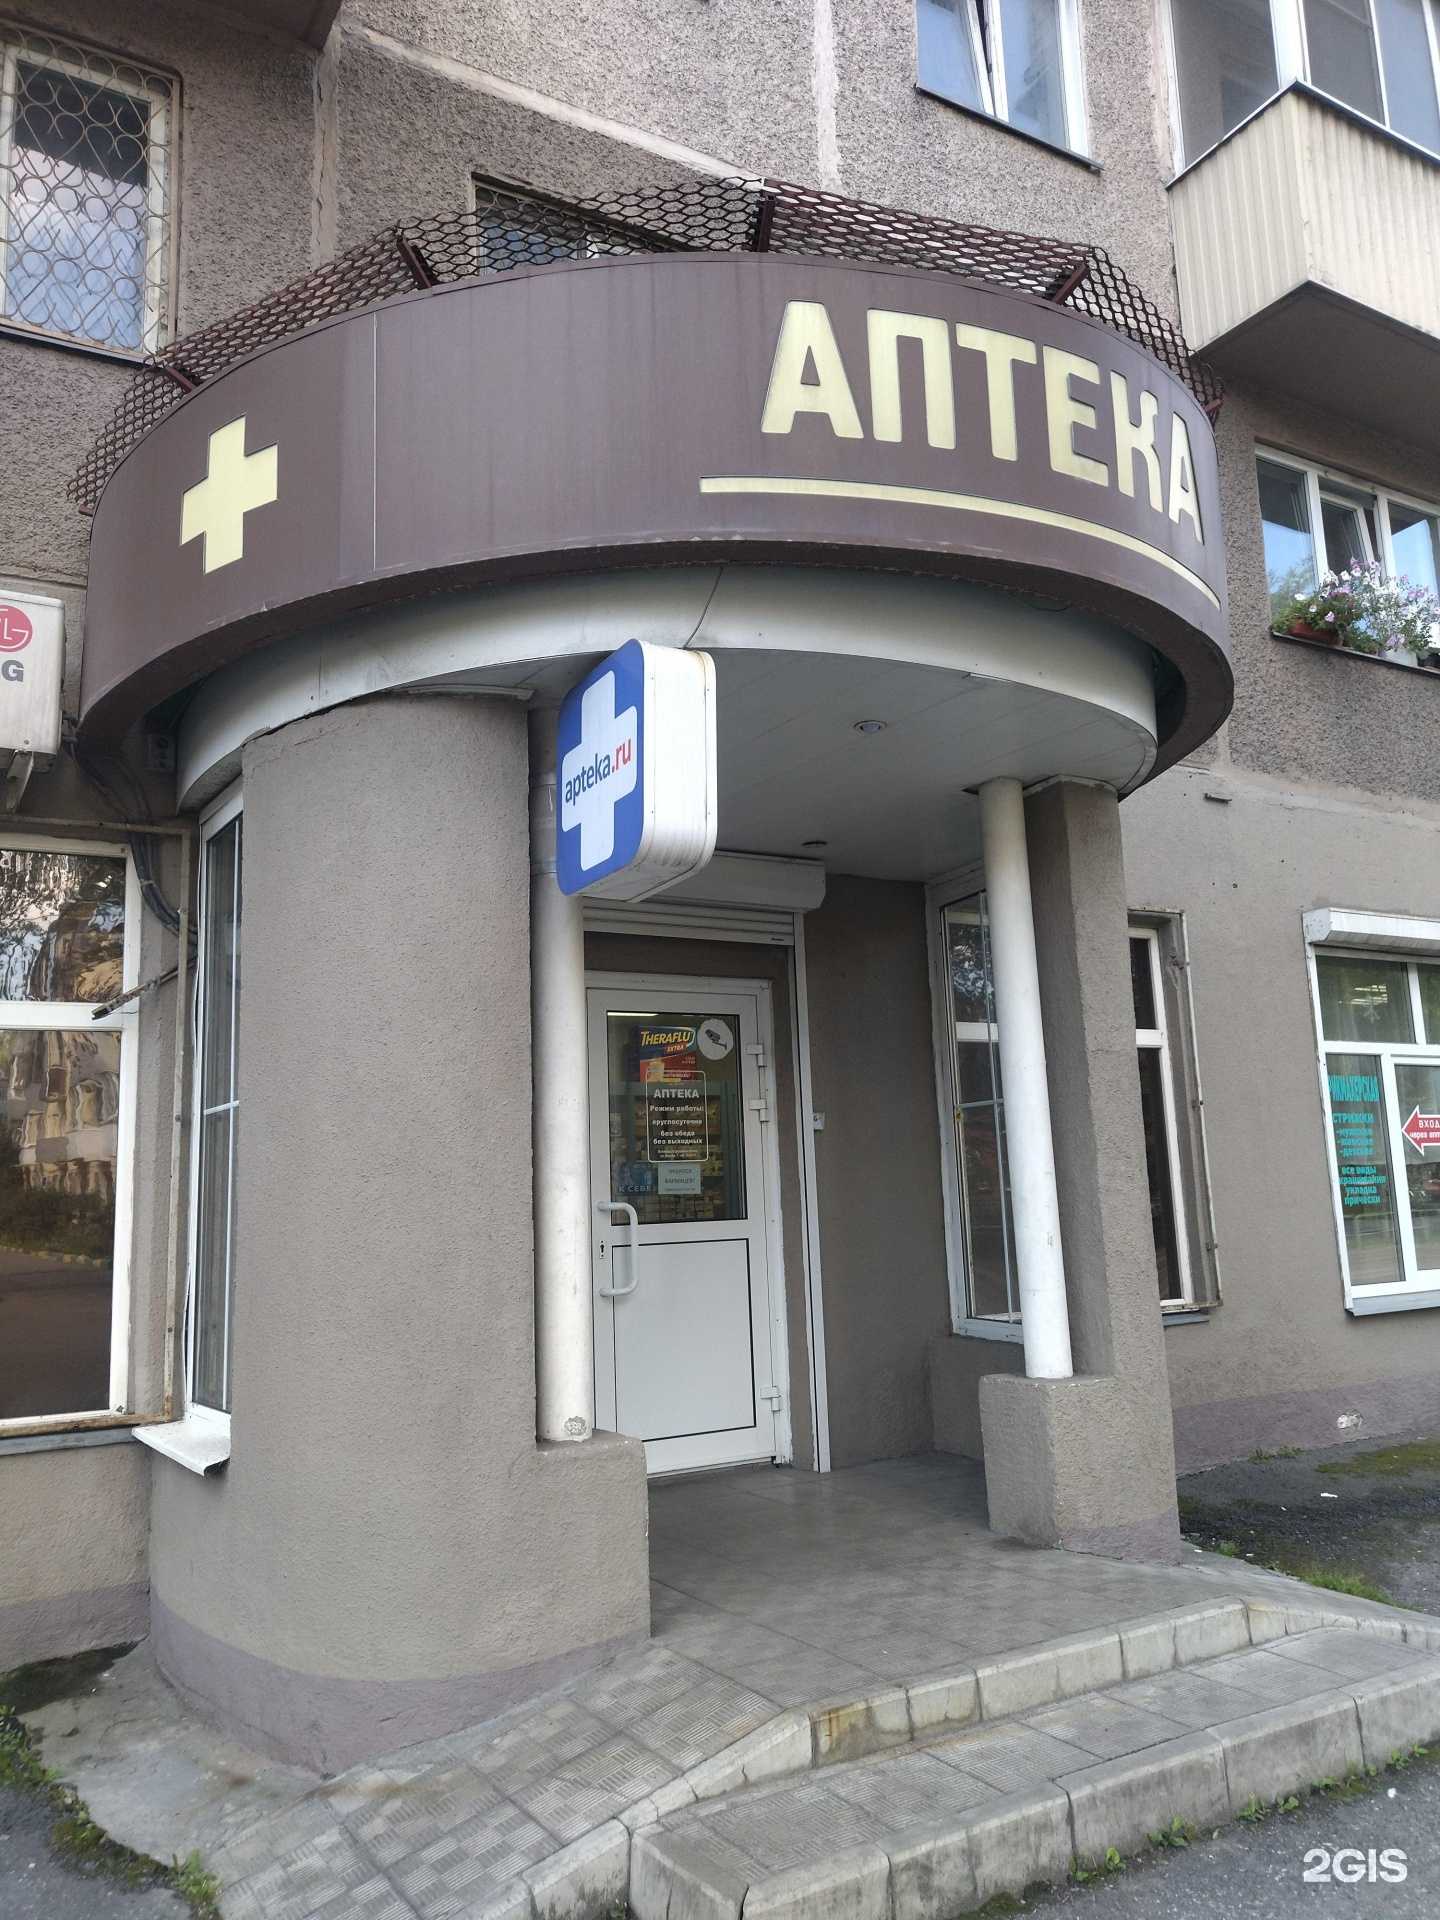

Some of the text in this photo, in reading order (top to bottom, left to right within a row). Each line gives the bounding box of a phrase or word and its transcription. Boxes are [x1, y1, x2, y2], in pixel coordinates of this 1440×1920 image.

[760, 299, 1205, 546] АПТЕКА
[564, 738, 633, 806] apteka.ru
[640, 1031, 691, 1047] THERAFLU
[653, 1088, 700, 1099] АПТЕКА
